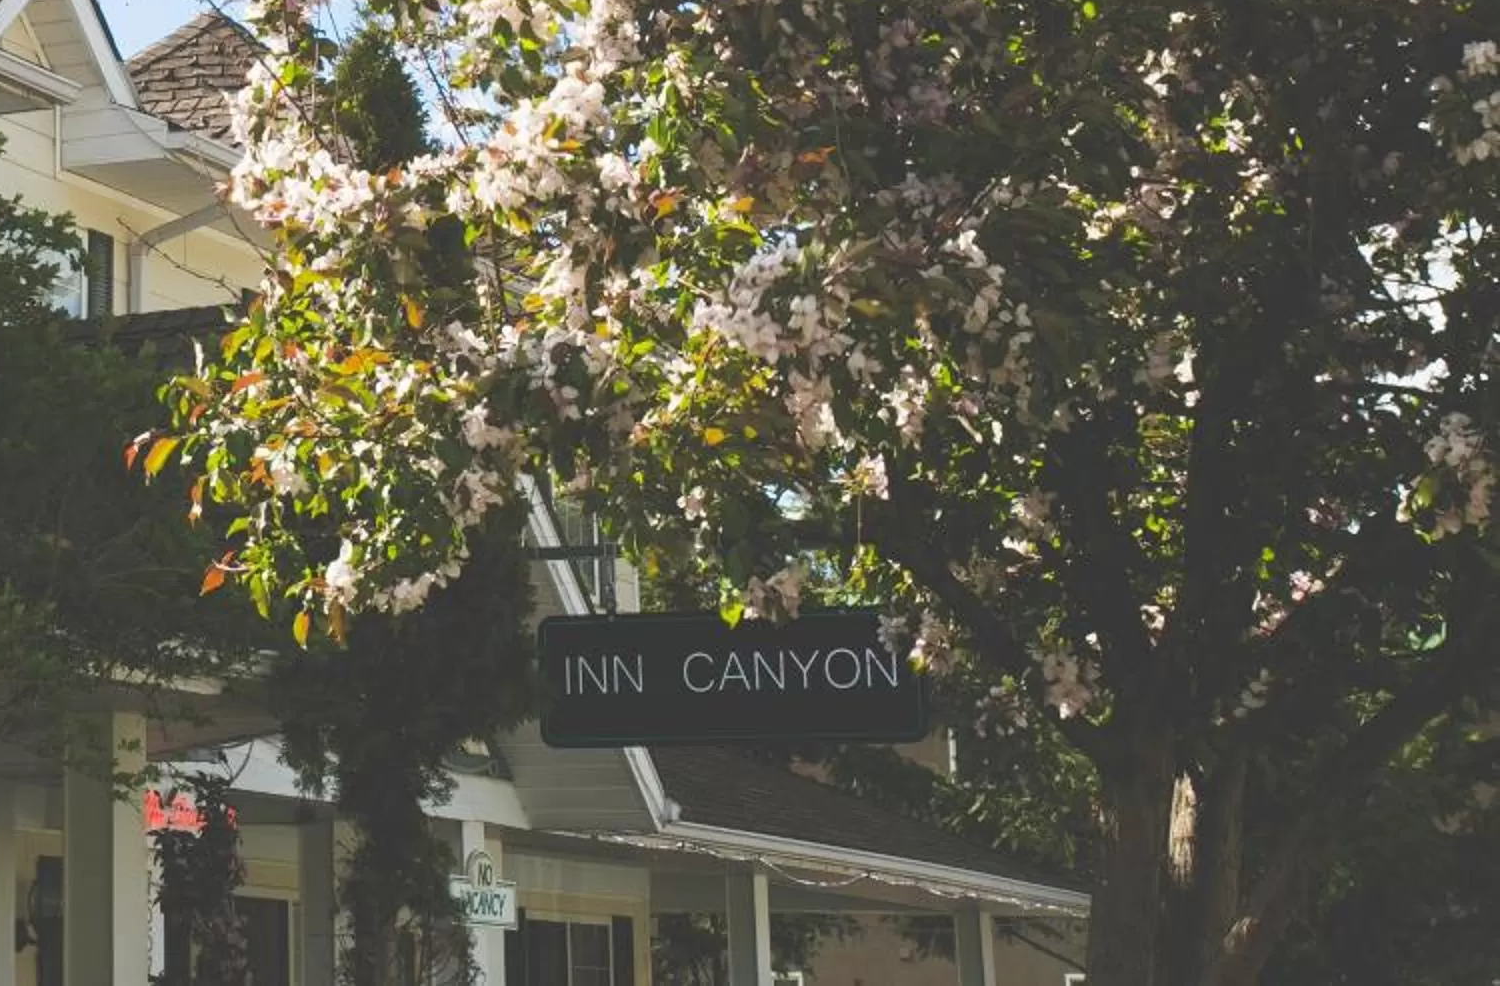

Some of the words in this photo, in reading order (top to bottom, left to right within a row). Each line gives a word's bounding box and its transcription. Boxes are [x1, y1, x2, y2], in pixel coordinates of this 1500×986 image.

[565, 654, 643, 695] INN
[683, 647, 899, 693] CANYON
[477, 861, 493, 887] NO
[459, 890, 508, 918] ACANCY
